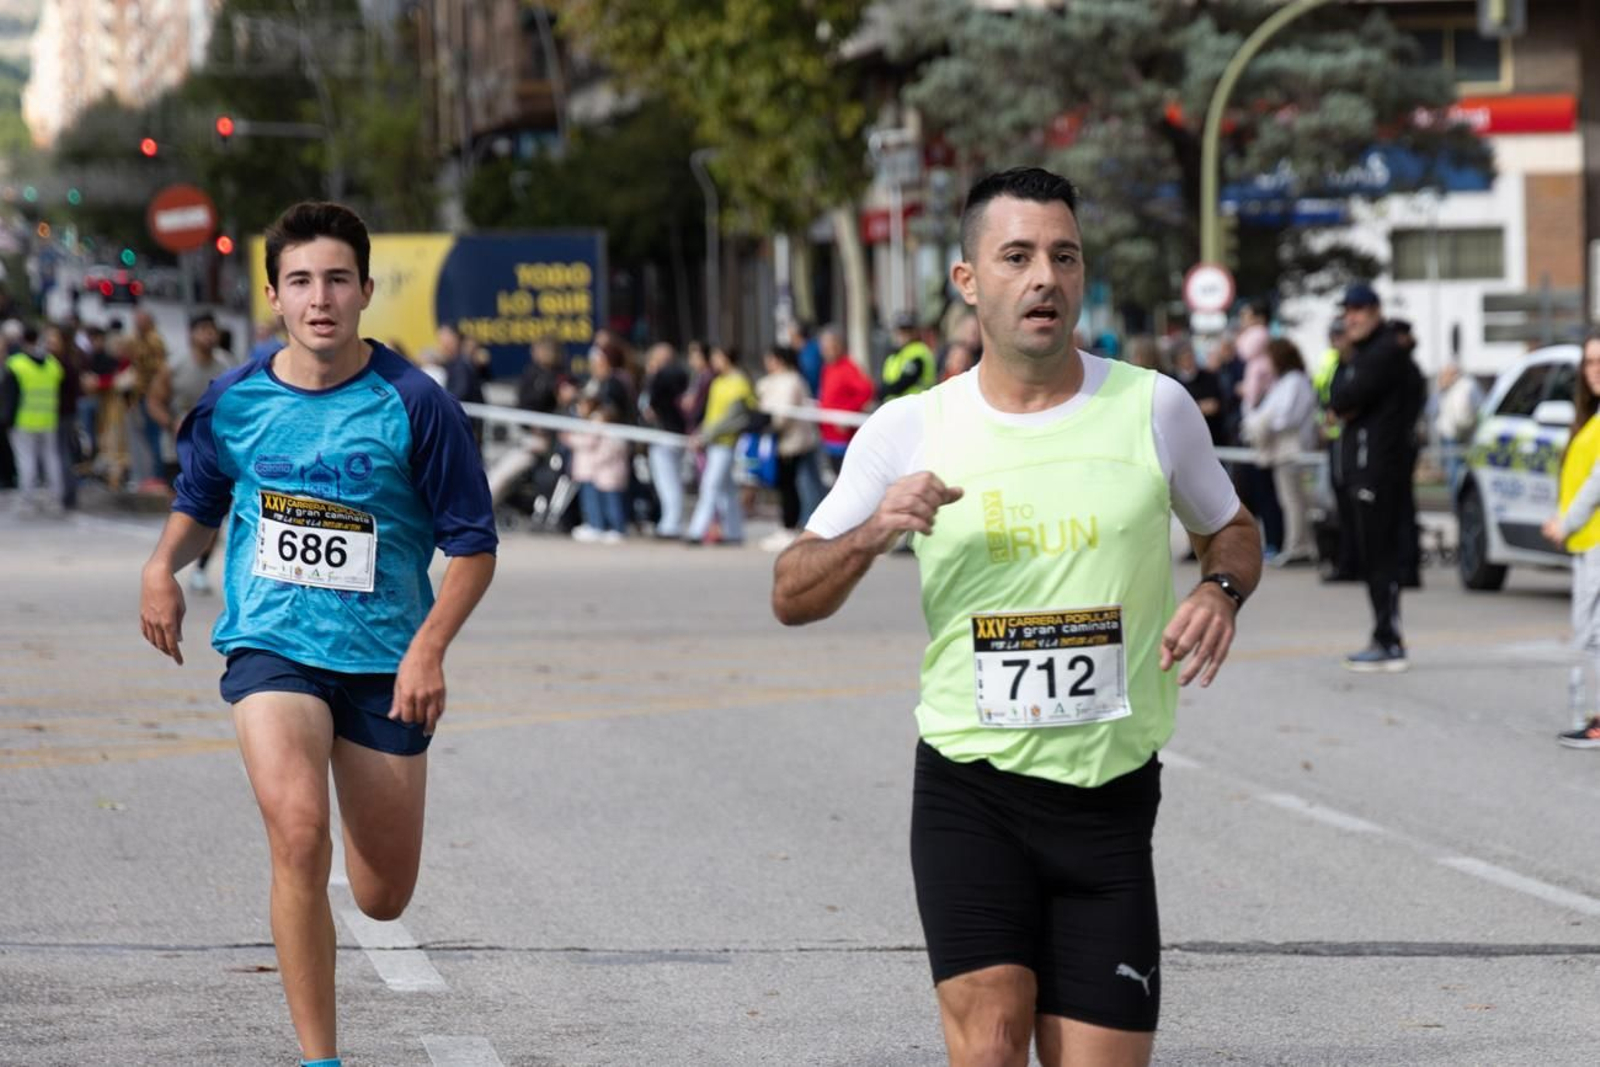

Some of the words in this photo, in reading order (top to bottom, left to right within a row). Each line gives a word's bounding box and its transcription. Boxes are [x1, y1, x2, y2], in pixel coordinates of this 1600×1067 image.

[515, 262, 592, 289] TODO
[497, 290, 533, 315] LO
[537, 290, 592, 315] QUE
[265, 495, 286, 512] XXV
[288, 500, 326, 512] CARRERA
[296, 508, 320, 517] gran
[325, 512, 369, 523] caminata
[1006, 504, 1035, 519] TO
[278, 530, 348, 568] 686
[1010, 514, 1099, 561] RUN
[977, 618, 1006, 638] XXV
[1008, 617, 1062, 627] CARRERA
[1066, 612, 1118, 623] POPULAR
[1008, 628, 1016, 638] y
[1023, 626, 1055, 637] gran
[1062, 621, 1118, 633] caminata
[1002, 654, 1096, 701] 712
